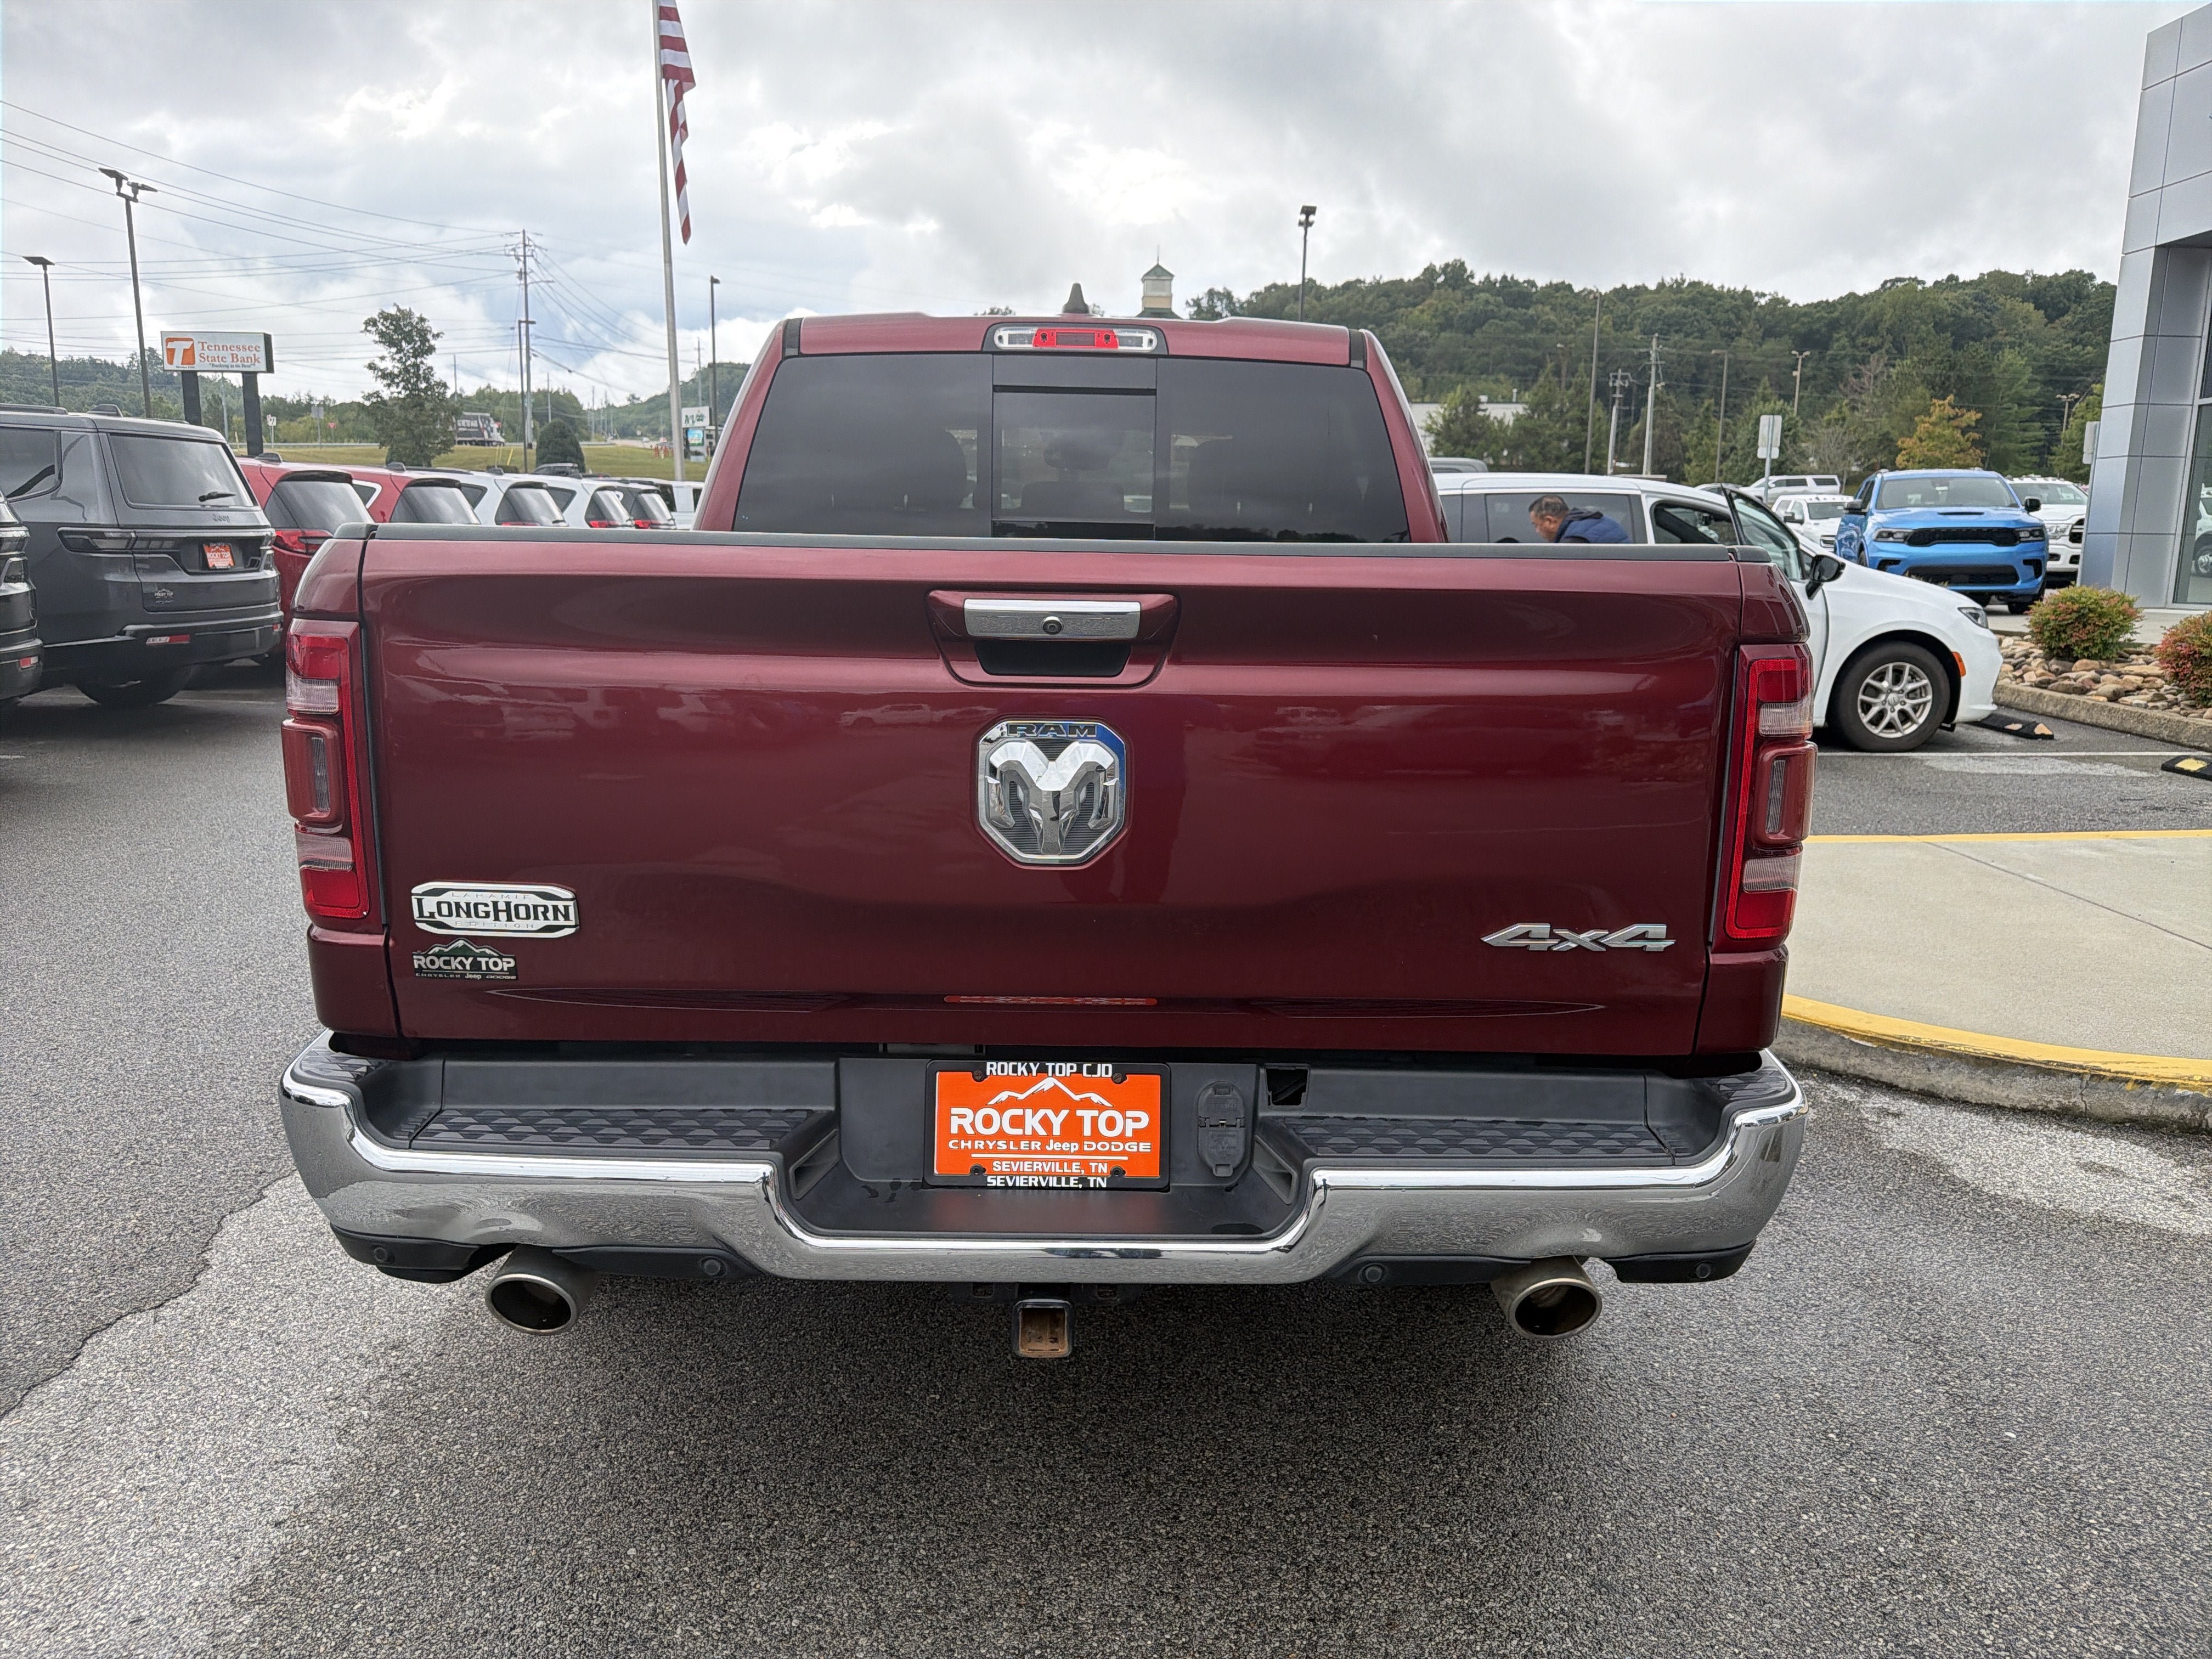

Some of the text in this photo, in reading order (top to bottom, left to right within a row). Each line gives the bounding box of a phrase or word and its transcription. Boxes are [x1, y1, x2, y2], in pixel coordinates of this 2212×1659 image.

[198, 341, 261, 352] Tennessee
[199, 353, 261, 364] State Bank
[1008, 724, 1097, 737] RAM
[452, 892, 531, 900] LARAMIE
[1480, 923, 1677, 952] 4x4
[413, 955, 515, 971] ROCKY TOP
[986, 1062, 1113, 1077] ROCKY TOP CJD
[950, 1107, 1149, 1137] ROCKY TOP
[948, 1139, 1152, 1153] CHRYSLER Jeep DODGE
[992, 1160, 1108, 1175] SEVIERVILLE, TN
[986, 1176, 1107, 1189] SEVIERVILLE, TN
